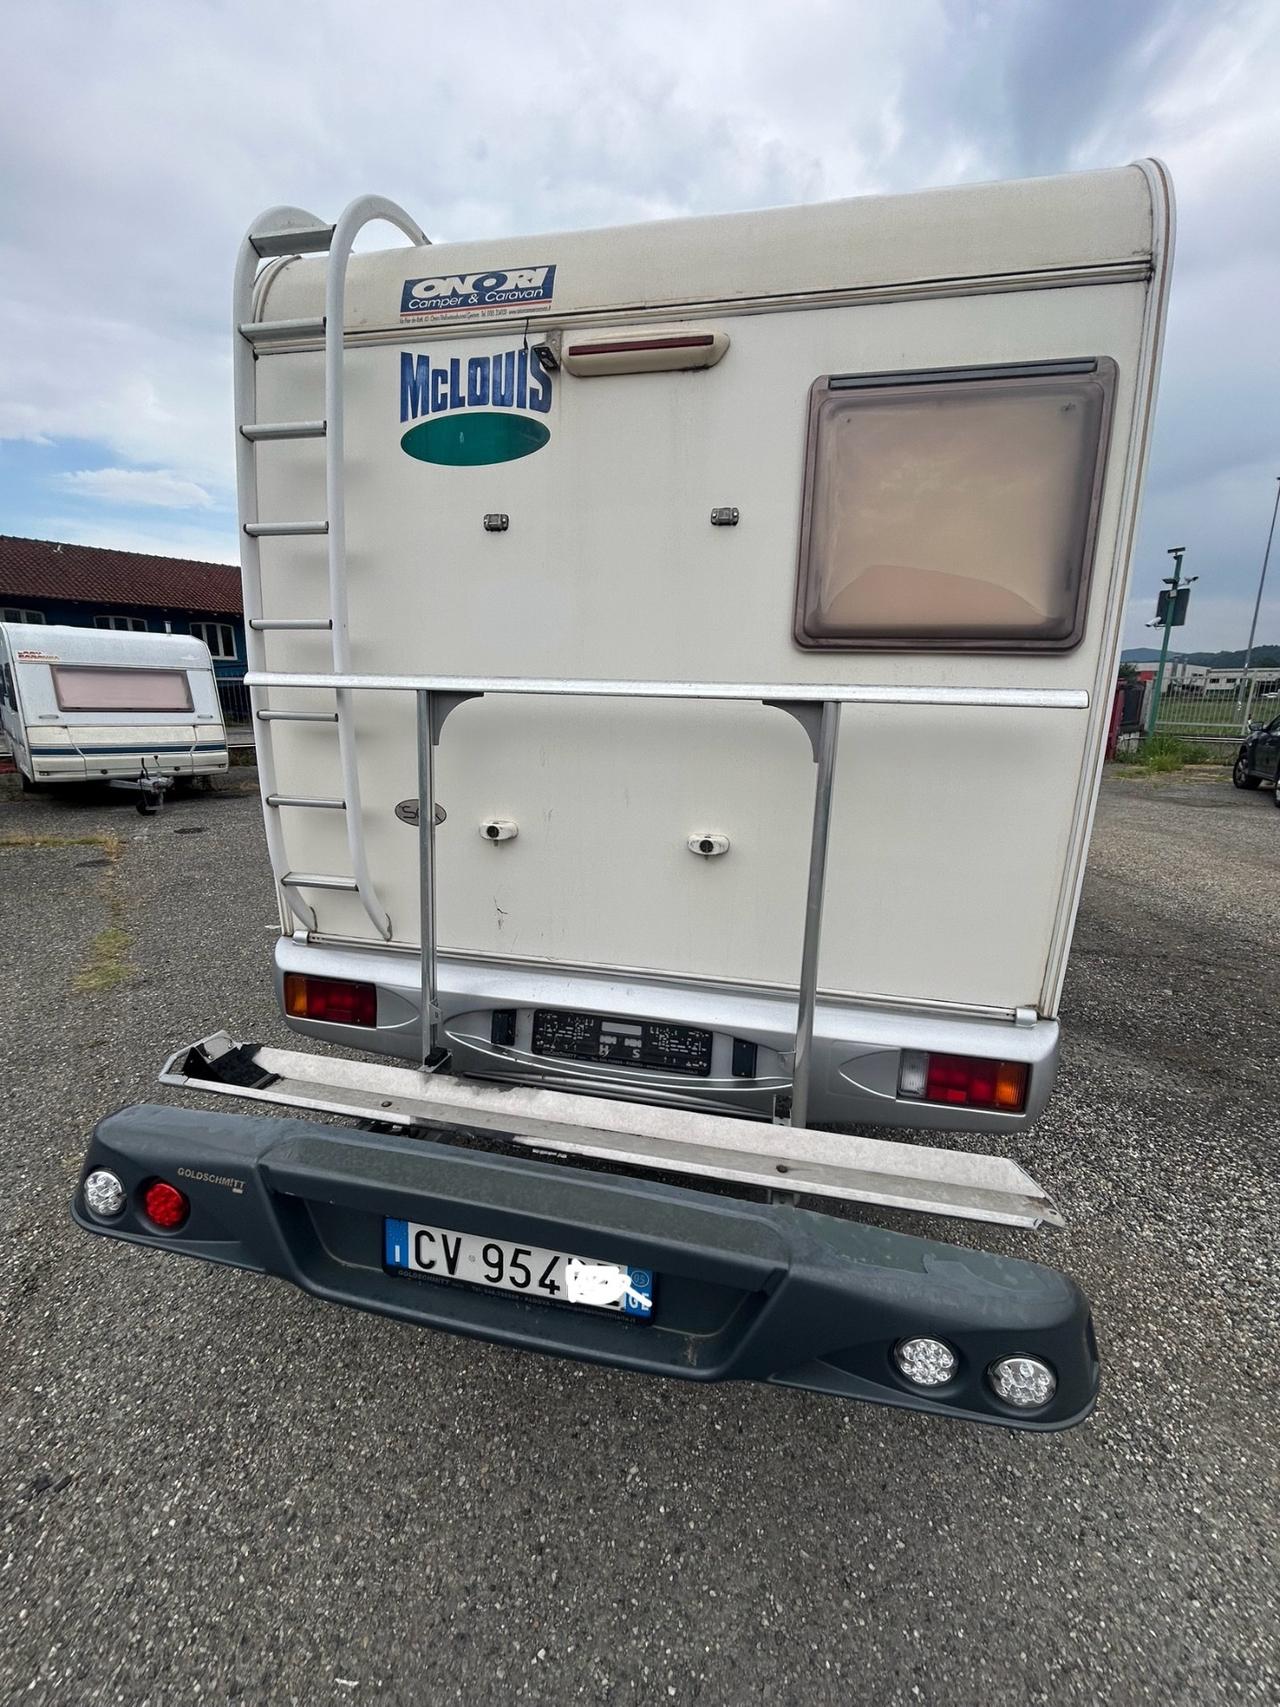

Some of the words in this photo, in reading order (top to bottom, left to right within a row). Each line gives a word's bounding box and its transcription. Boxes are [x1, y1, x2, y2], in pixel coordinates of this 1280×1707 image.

[408, 296, 464, 309] Camper
[468, 293, 479, 304] &
[485, 289, 544, 302] Caravan
[177, 1167, 246, 1189] GOLDSCHMITT
[414, 1230, 462, 1276] CV
